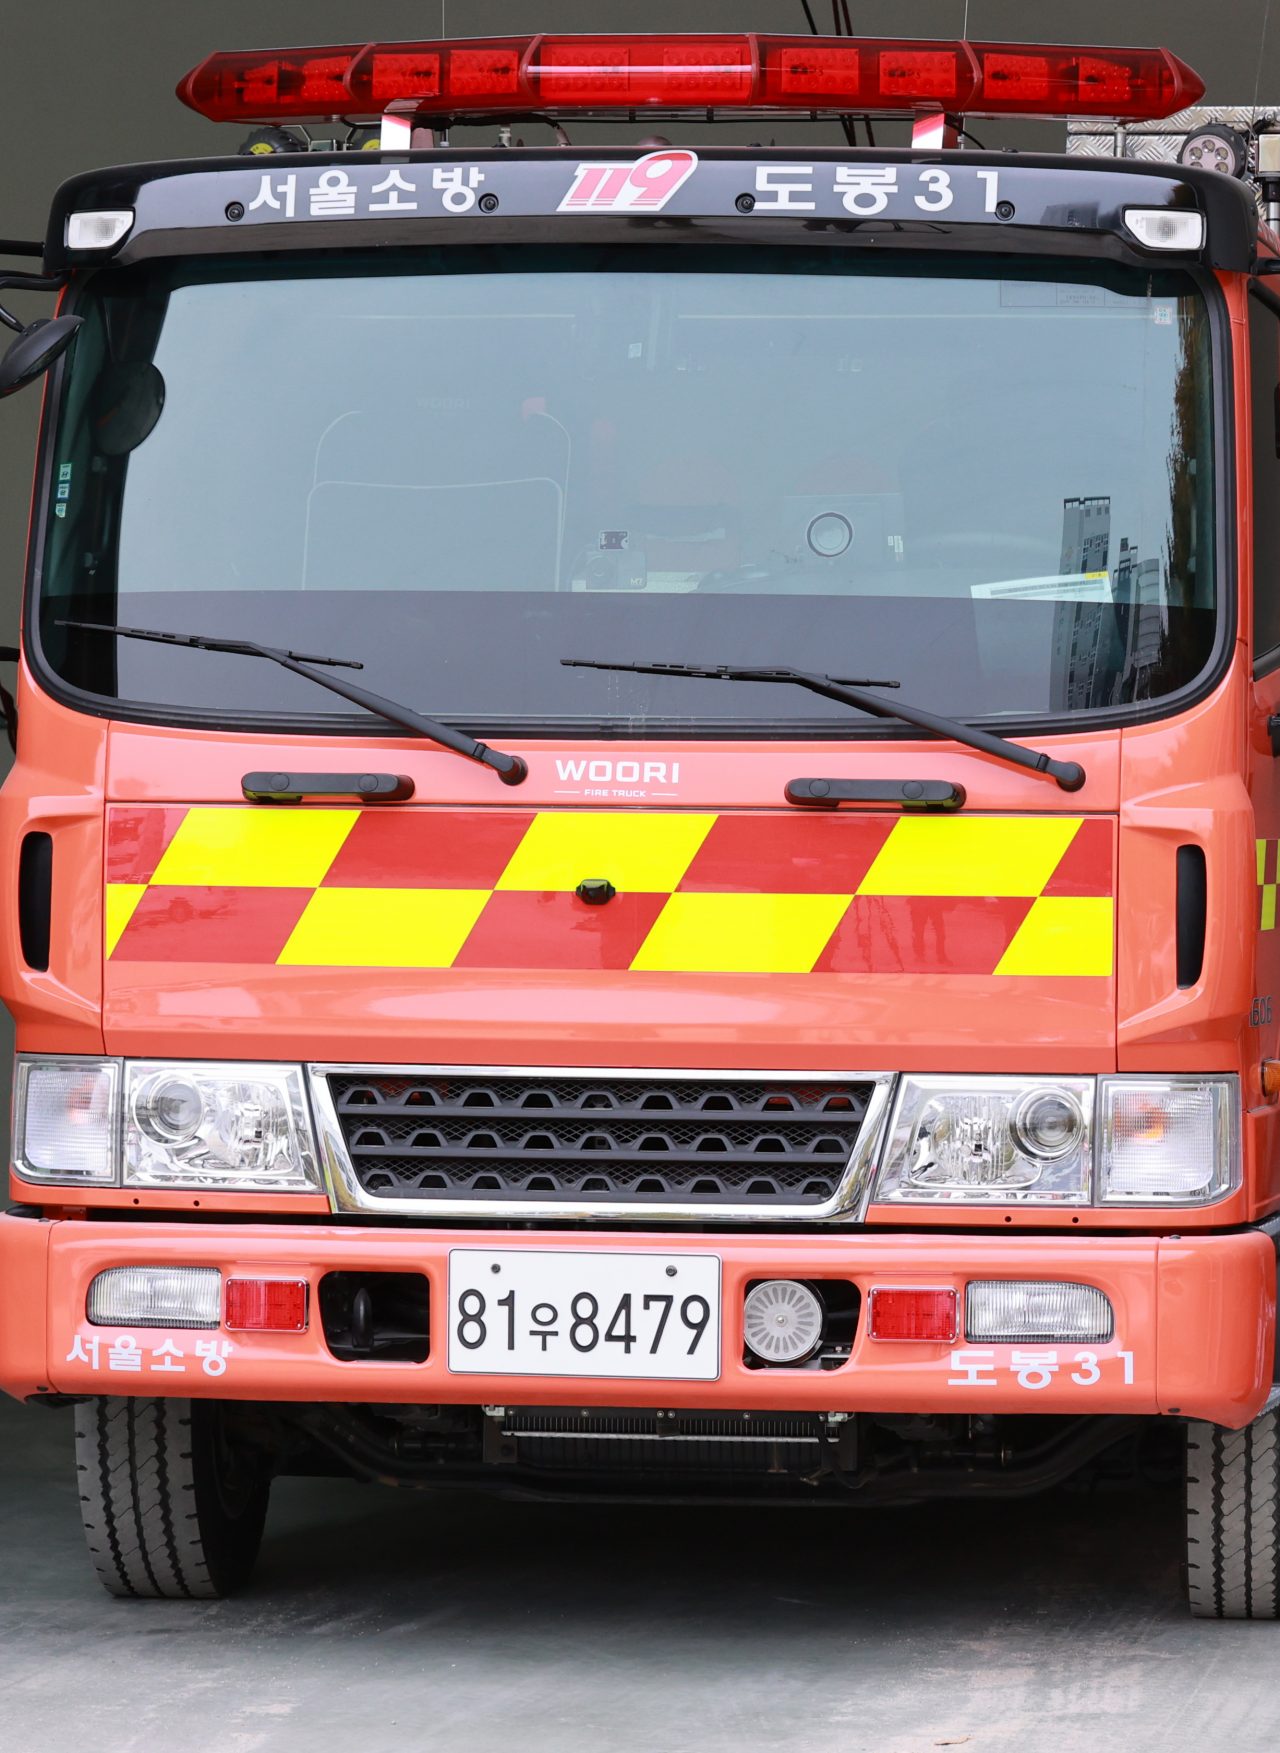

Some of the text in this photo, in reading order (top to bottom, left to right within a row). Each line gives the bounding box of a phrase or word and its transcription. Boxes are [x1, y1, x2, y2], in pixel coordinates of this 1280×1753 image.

[249, 167, 485, 217] 서울소방
[556, 150, 699, 212] 119
[753, 166, 999, 215] 도봉31
[555, 759, 680, 783] WOORI
[584, 789, 646, 798] FIRE TRUCK
[457, 1289, 710, 1355] 81우8479
[66, 1334, 234, 1377] 서울소방
[948, 1350, 1135, 1389] 도봉31
